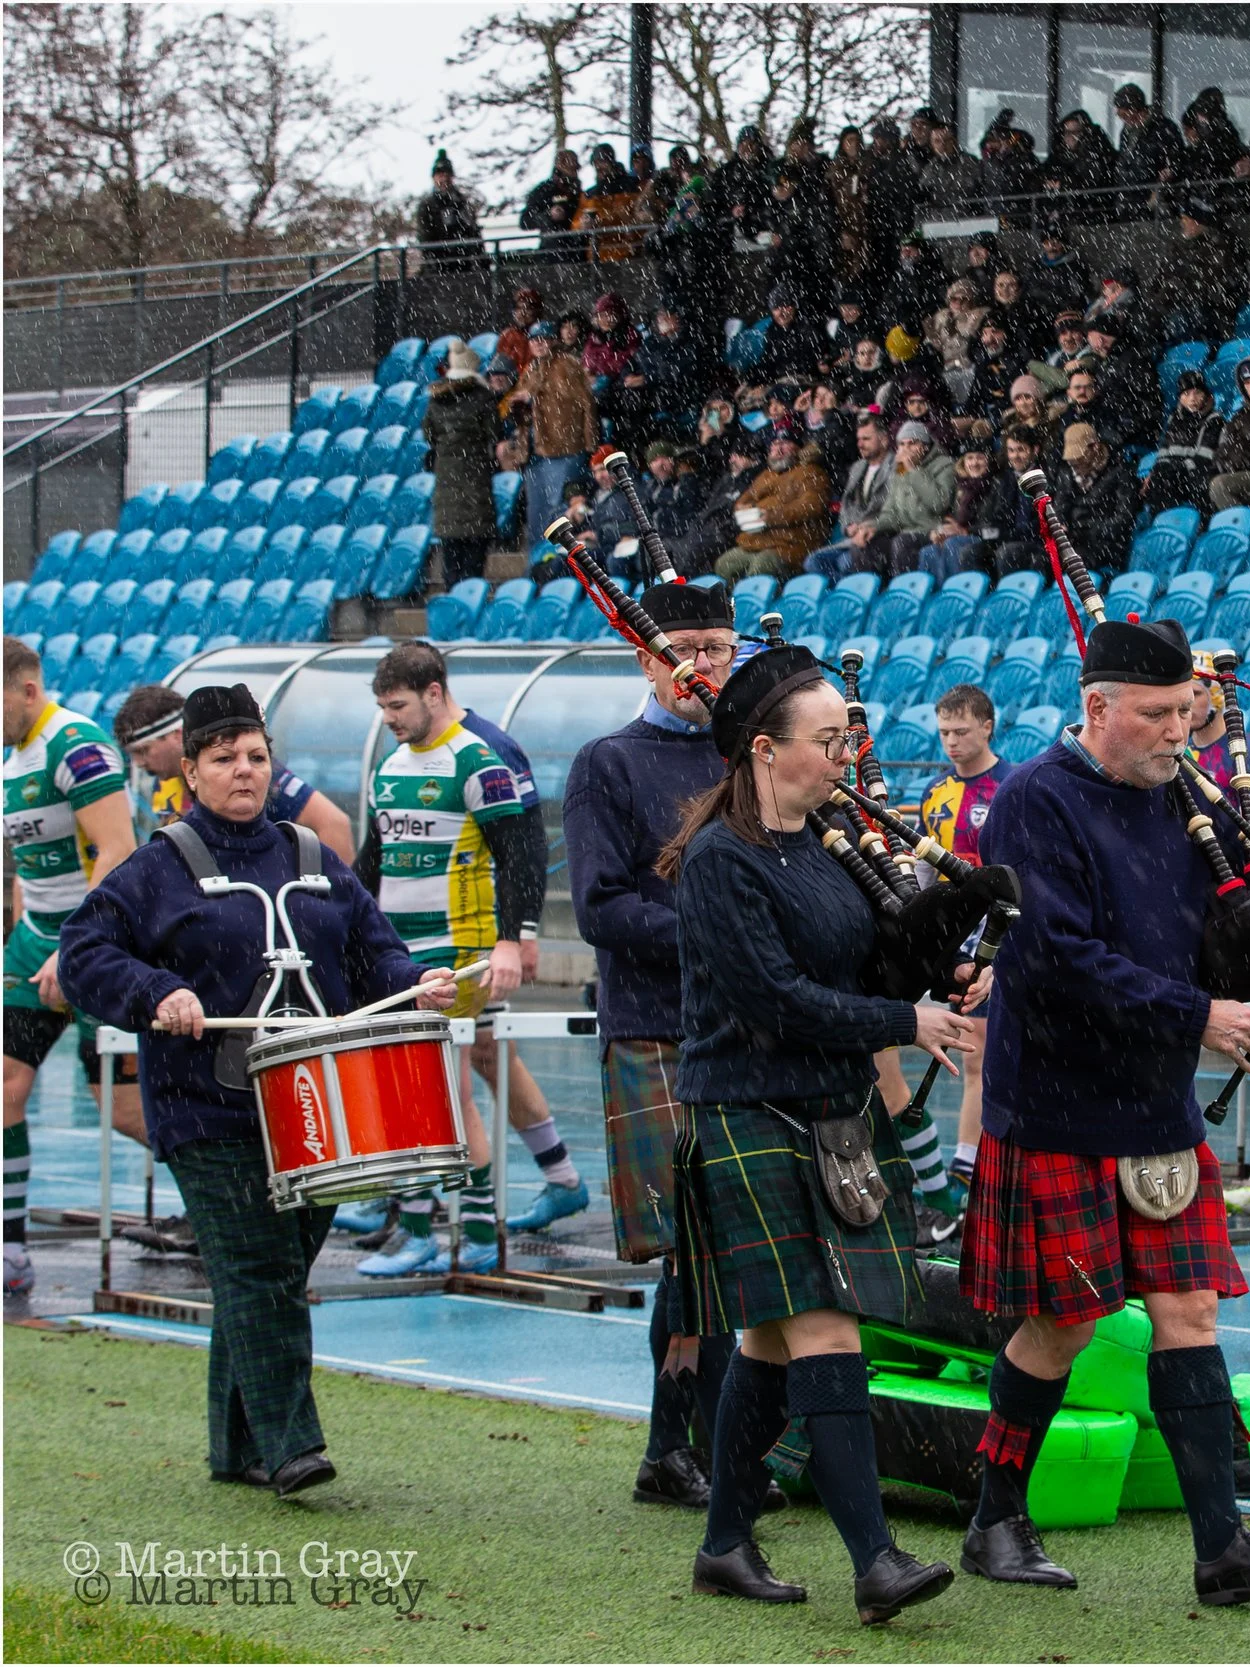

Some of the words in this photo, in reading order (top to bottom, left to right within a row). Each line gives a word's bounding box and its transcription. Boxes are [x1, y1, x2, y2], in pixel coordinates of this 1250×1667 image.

[3, 817, 44, 844] gier
[378, 811, 436, 841] Ogier
[298, 1082, 325, 1161] ANDANTE
